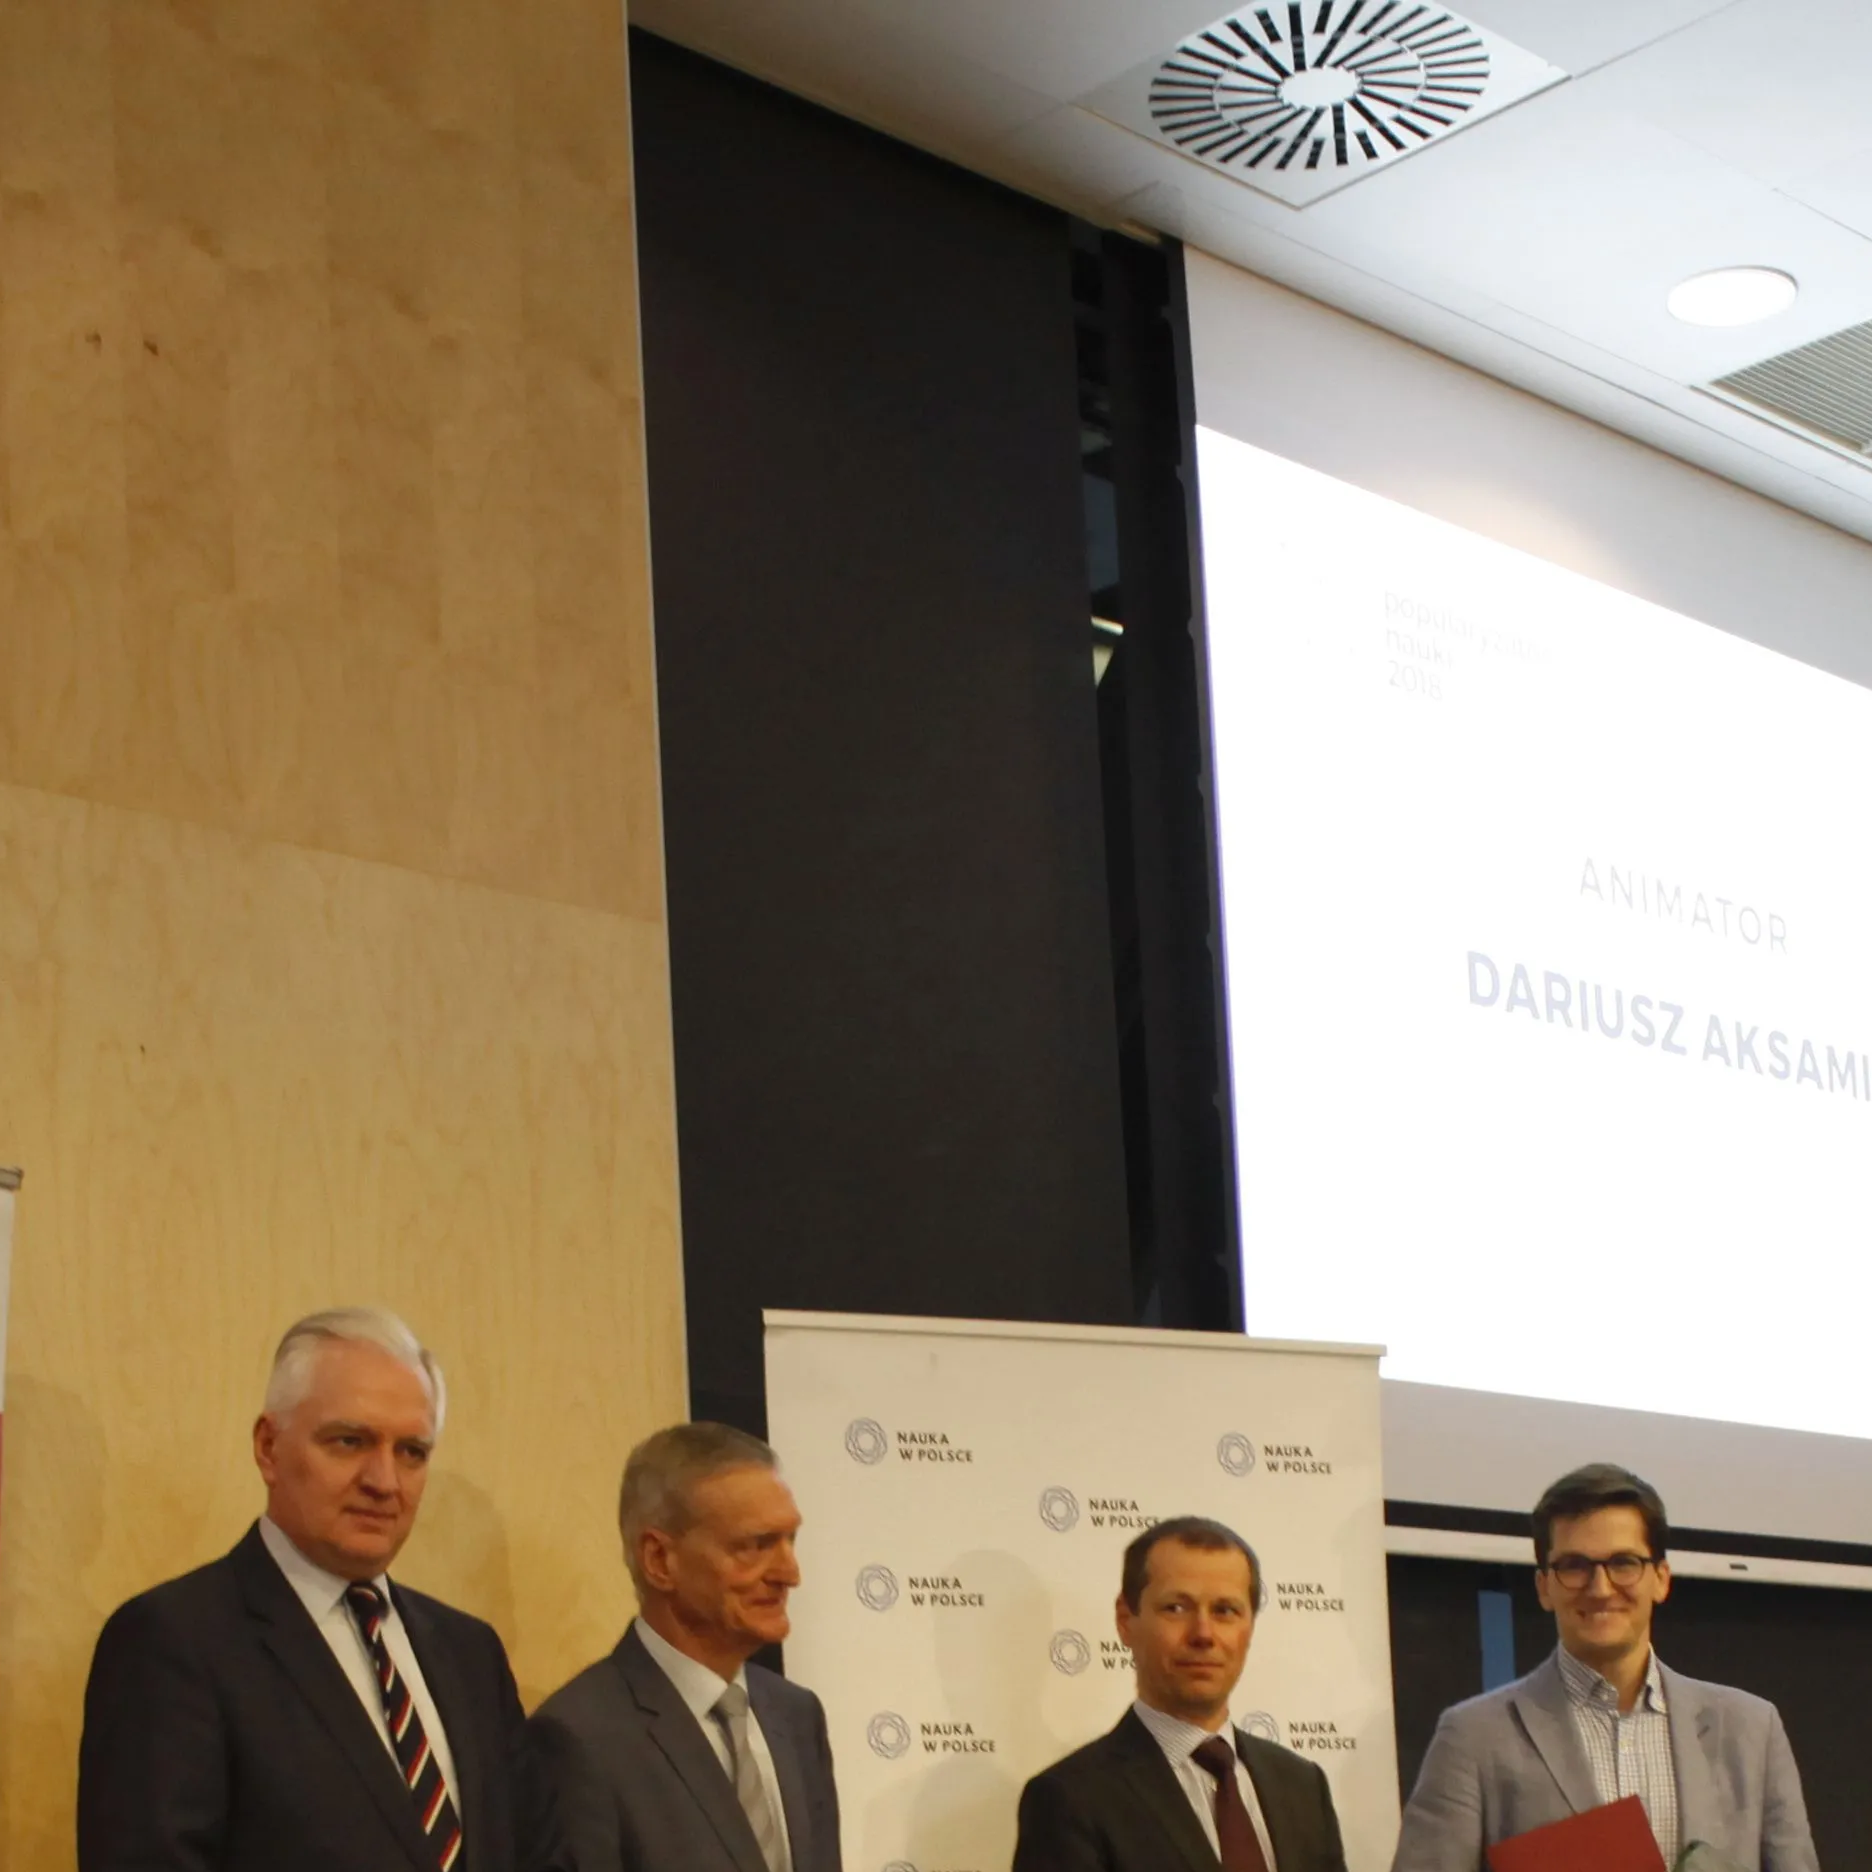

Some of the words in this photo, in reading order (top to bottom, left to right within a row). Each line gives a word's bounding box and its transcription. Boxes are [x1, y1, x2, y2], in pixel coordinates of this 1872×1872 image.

[1387, 658, 1444, 703] 2018
[1579, 855, 1790, 956] ANIMATOR
[1465, 949, 1689, 1058] DARIUSZ
[897, 1431, 949, 1445] NAUKA
[899, 1448, 914, 1462] W
[918, 1449, 973, 1463] POLSCE
[1264, 1444, 1313, 1457] NAUKA
[1266, 1461, 1279, 1473] W
[1284, 1462, 1332, 1475] POLSCE
[1089, 1498, 1139, 1512] NAUKA
[1091, 1515, 1104, 1528] W
[908, 1576, 962, 1590] NAUKA
[1276, 1582, 1325, 1595] NAUKA
[911, 1593, 925, 1606] W
[930, 1593, 985, 1607] POLSCE
[1279, 1599, 1291, 1611] W
[1296, 1599, 1345, 1612] POLSCE
[921, 1722, 974, 1736] NAUKA
[1289, 1720, 1337, 1734] NAUKA
[922, 1739, 937, 1753] W
[942, 1739, 996, 1753] POLSCE
[1291, 1738, 1304, 1750] W
[1309, 1737, 1357, 1750] POLSCE
